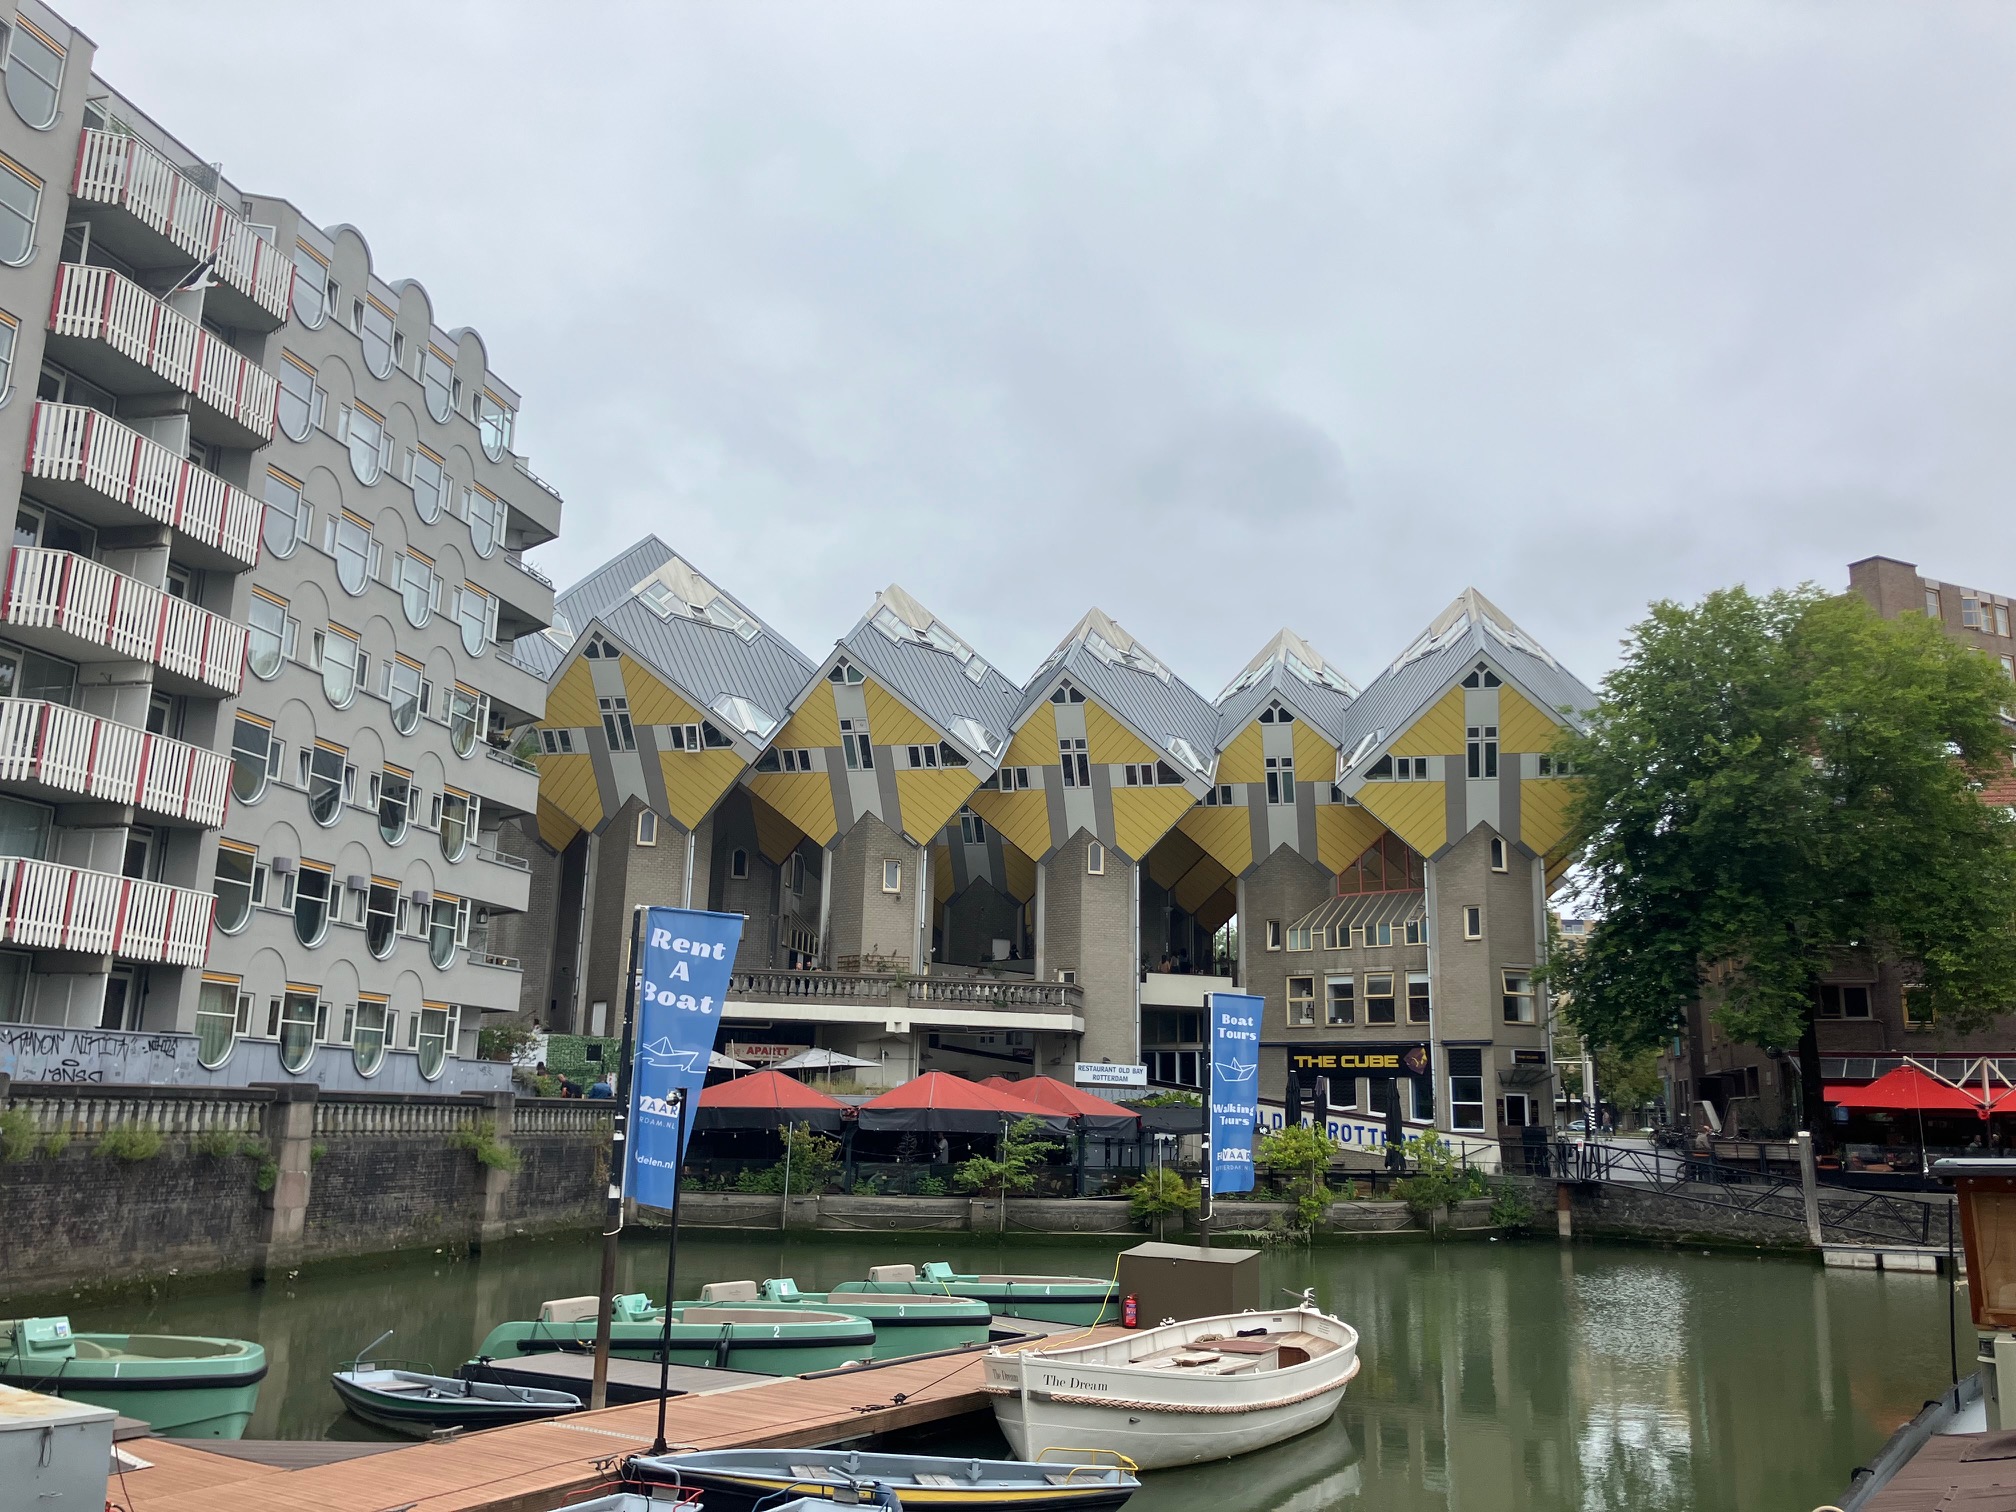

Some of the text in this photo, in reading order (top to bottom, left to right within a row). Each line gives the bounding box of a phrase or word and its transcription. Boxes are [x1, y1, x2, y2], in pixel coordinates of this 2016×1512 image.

[650, 928, 726, 961] Rent
[669, 961, 690, 982] A
[645, 980, 714, 1014] Boat
[1221, 1014, 1254, 1027] Boat
[1217, 1027, 1257, 1041] Tours
[1294, 1055, 1399, 1068] THE CUBE
[1078, 1065, 1117, 1074] RESTAURANT
[1132, 1067, 1144, 1075] BAY
[1092, 1074, 1128, 1082] ROTTERDAM
[1213, 1103, 1255, 1117] Walking
[1255, 1111, 1283, 1130] LD
[1045, 1285, 1051, 1296] 4
[899, 1305, 905, 1317] 3
[773, 1325, 780, 1338] 2
[992, 1368, 1019, 1383] The Dream
[1043, 1374, 1108, 1391] The Dream
